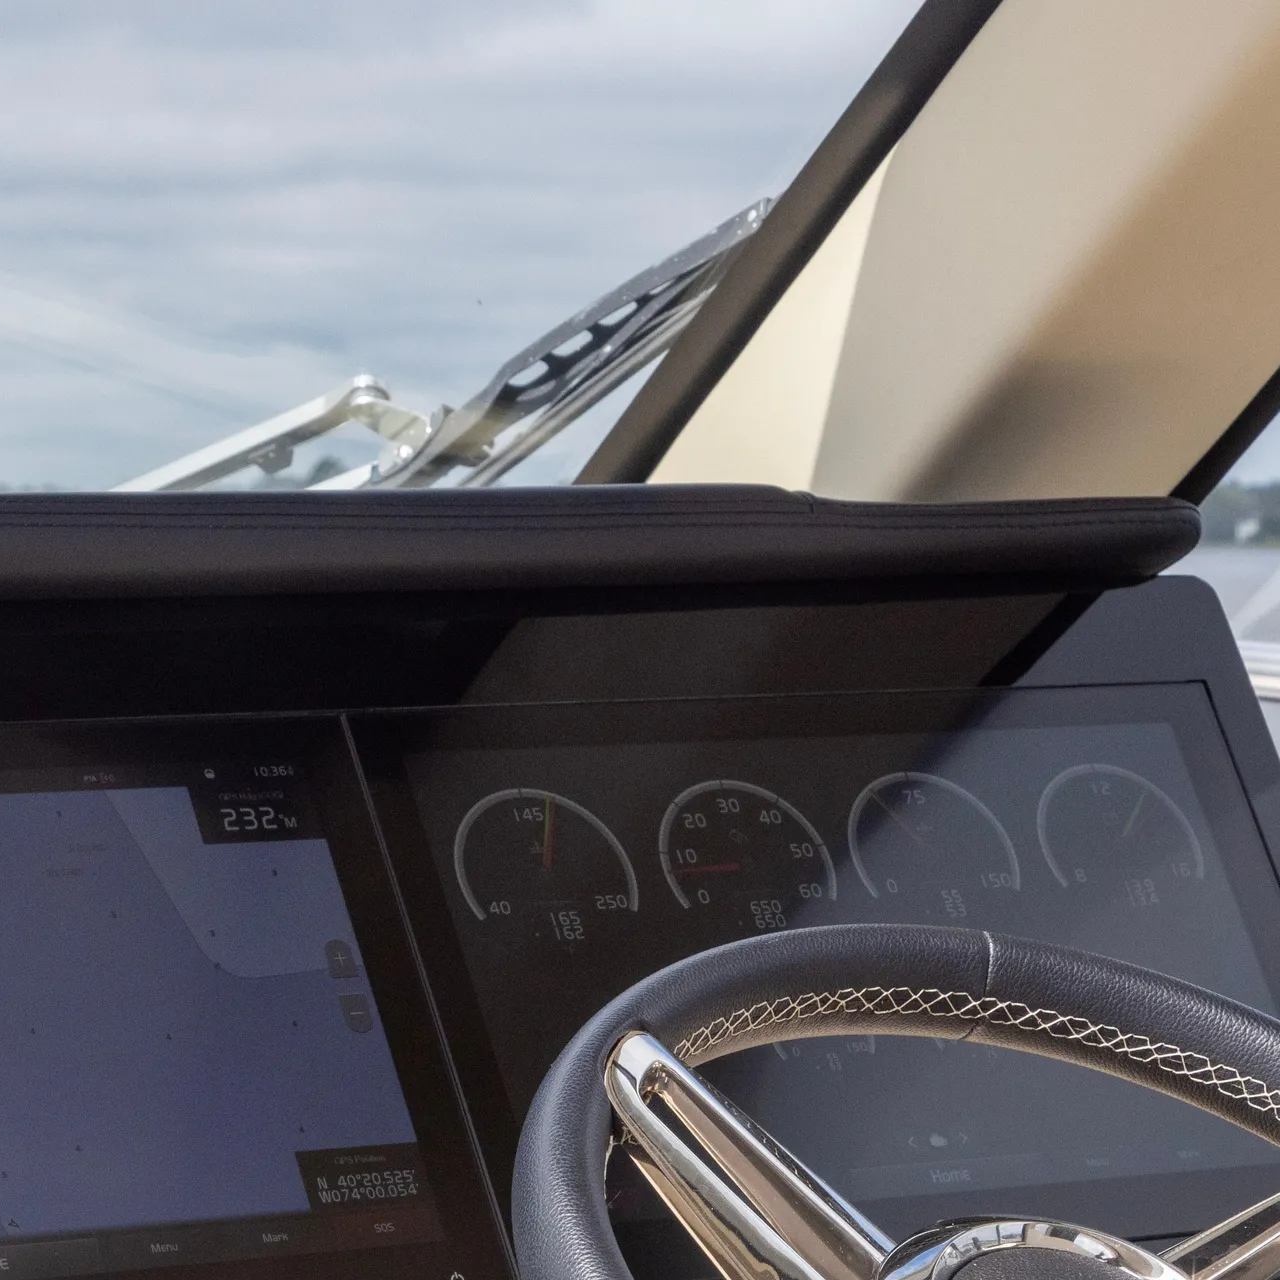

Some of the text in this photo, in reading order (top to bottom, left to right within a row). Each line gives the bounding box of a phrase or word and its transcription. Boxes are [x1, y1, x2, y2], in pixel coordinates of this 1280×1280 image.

[1090, 781, 1112, 796] 12
[901, 789, 925, 804] 75
[716, 798, 740, 813] 30
[513, 805, 544, 822] 145
[683, 813, 707, 828] 20
[759, 809, 782, 825] 40
[677, 849, 698, 864] 10
[790, 843, 814, 858] 50
[1074, 868, 1088, 883] 8
[1170, 861, 1191, 878] 16
[885, 879, 899, 894] 0
[980, 873, 1011, 888] 150
[697, 890, 712, 905] 0
[800, 883, 823, 899] 60
[489, 900, 511, 916] 40
[595, 894, 628, 910] 250
[751, 900, 783, 915] 650
[550, 911, 582, 926] 165
[755, 914, 788, 929] 650
[555, 926, 585, 942] 162
[316, 1176, 328, 1189] N
[929, 1167, 971, 1183] Home
[373, 1223, 395, 1233] SOS
[262, 1231, 289, 1244] Mark
[150, 1241, 179, 1254] Menu
